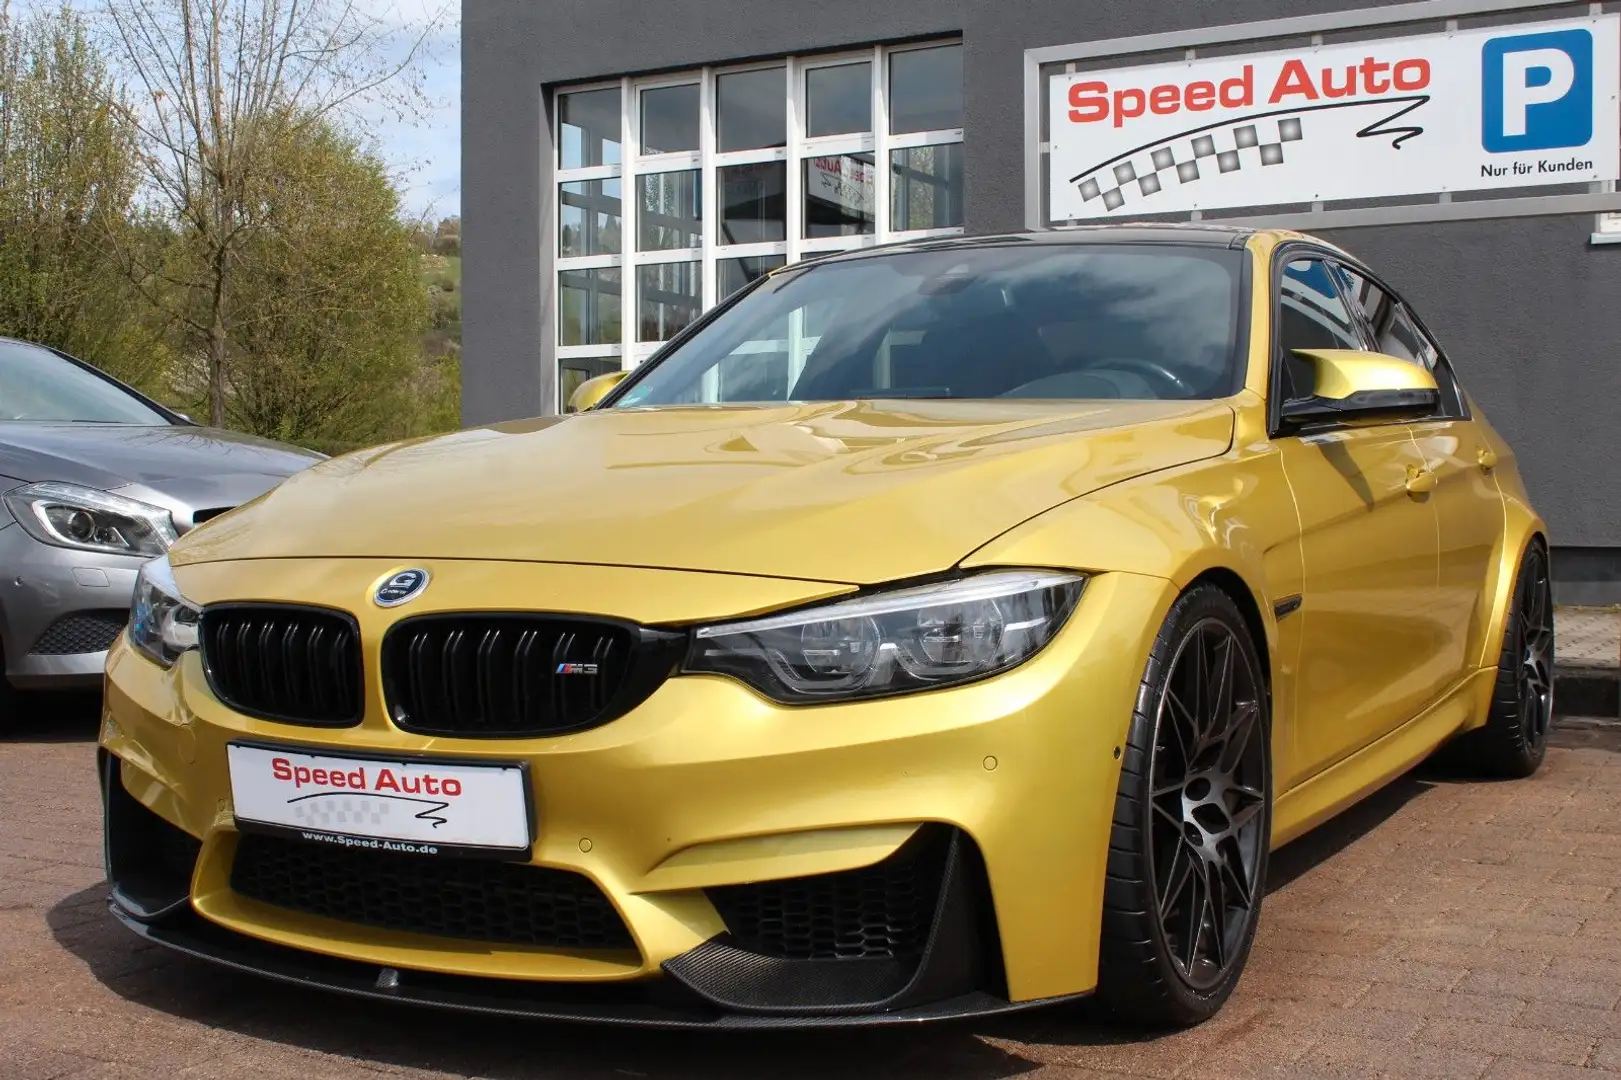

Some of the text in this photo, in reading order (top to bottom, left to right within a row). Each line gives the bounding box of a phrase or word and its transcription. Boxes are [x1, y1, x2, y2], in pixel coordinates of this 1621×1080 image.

[1067, 57, 1431, 128] Speed Auto
[1502, 48, 1575, 137] P
[1481, 157, 1593, 177] Nur für Kunden
[568, 663, 598, 674] M3
[272, 757, 462, 797] Speed Auto
[301, 831, 438, 855] www.Speed-Auto.de
